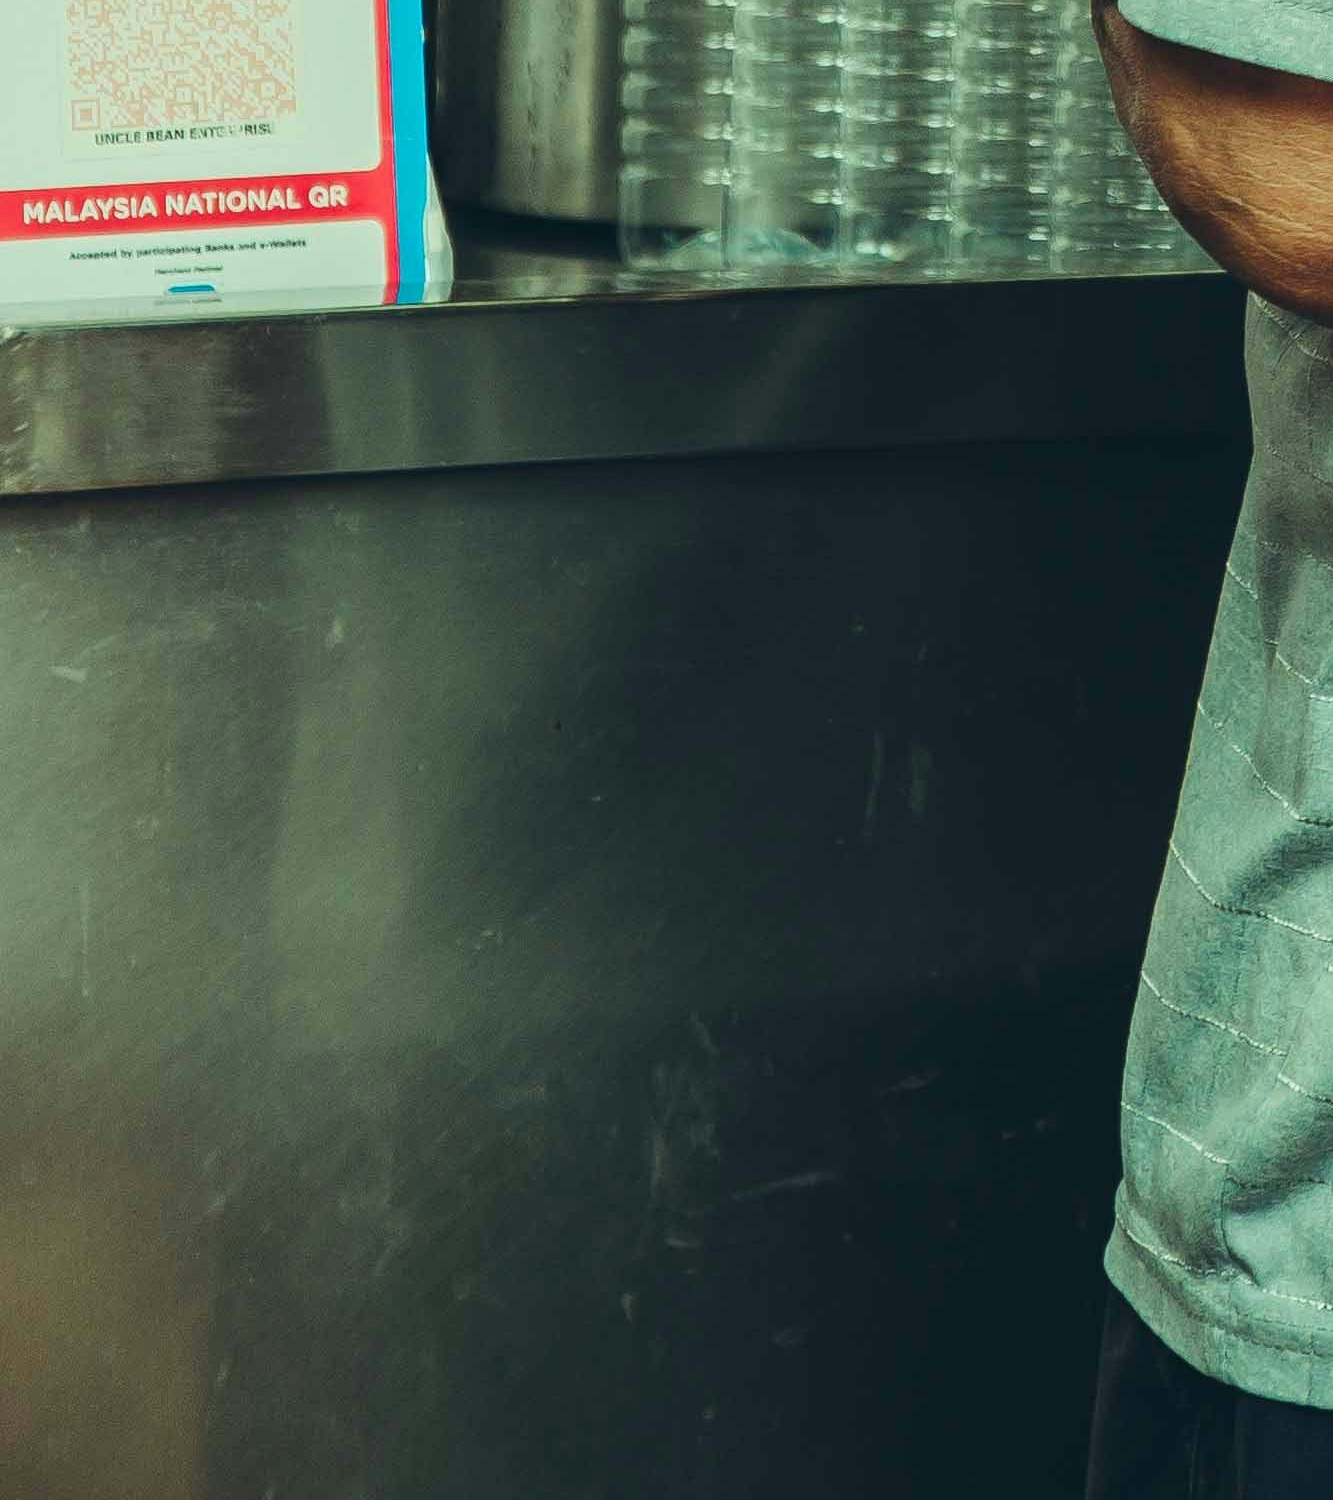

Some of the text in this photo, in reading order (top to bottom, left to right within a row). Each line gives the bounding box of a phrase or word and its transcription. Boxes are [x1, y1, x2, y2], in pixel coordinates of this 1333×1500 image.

[94, 131, 141, 146] UNCLE
[146, 128, 185, 143] BEAN
[22, 183, 348, 225] MALAYSIA NATIONAL QR
